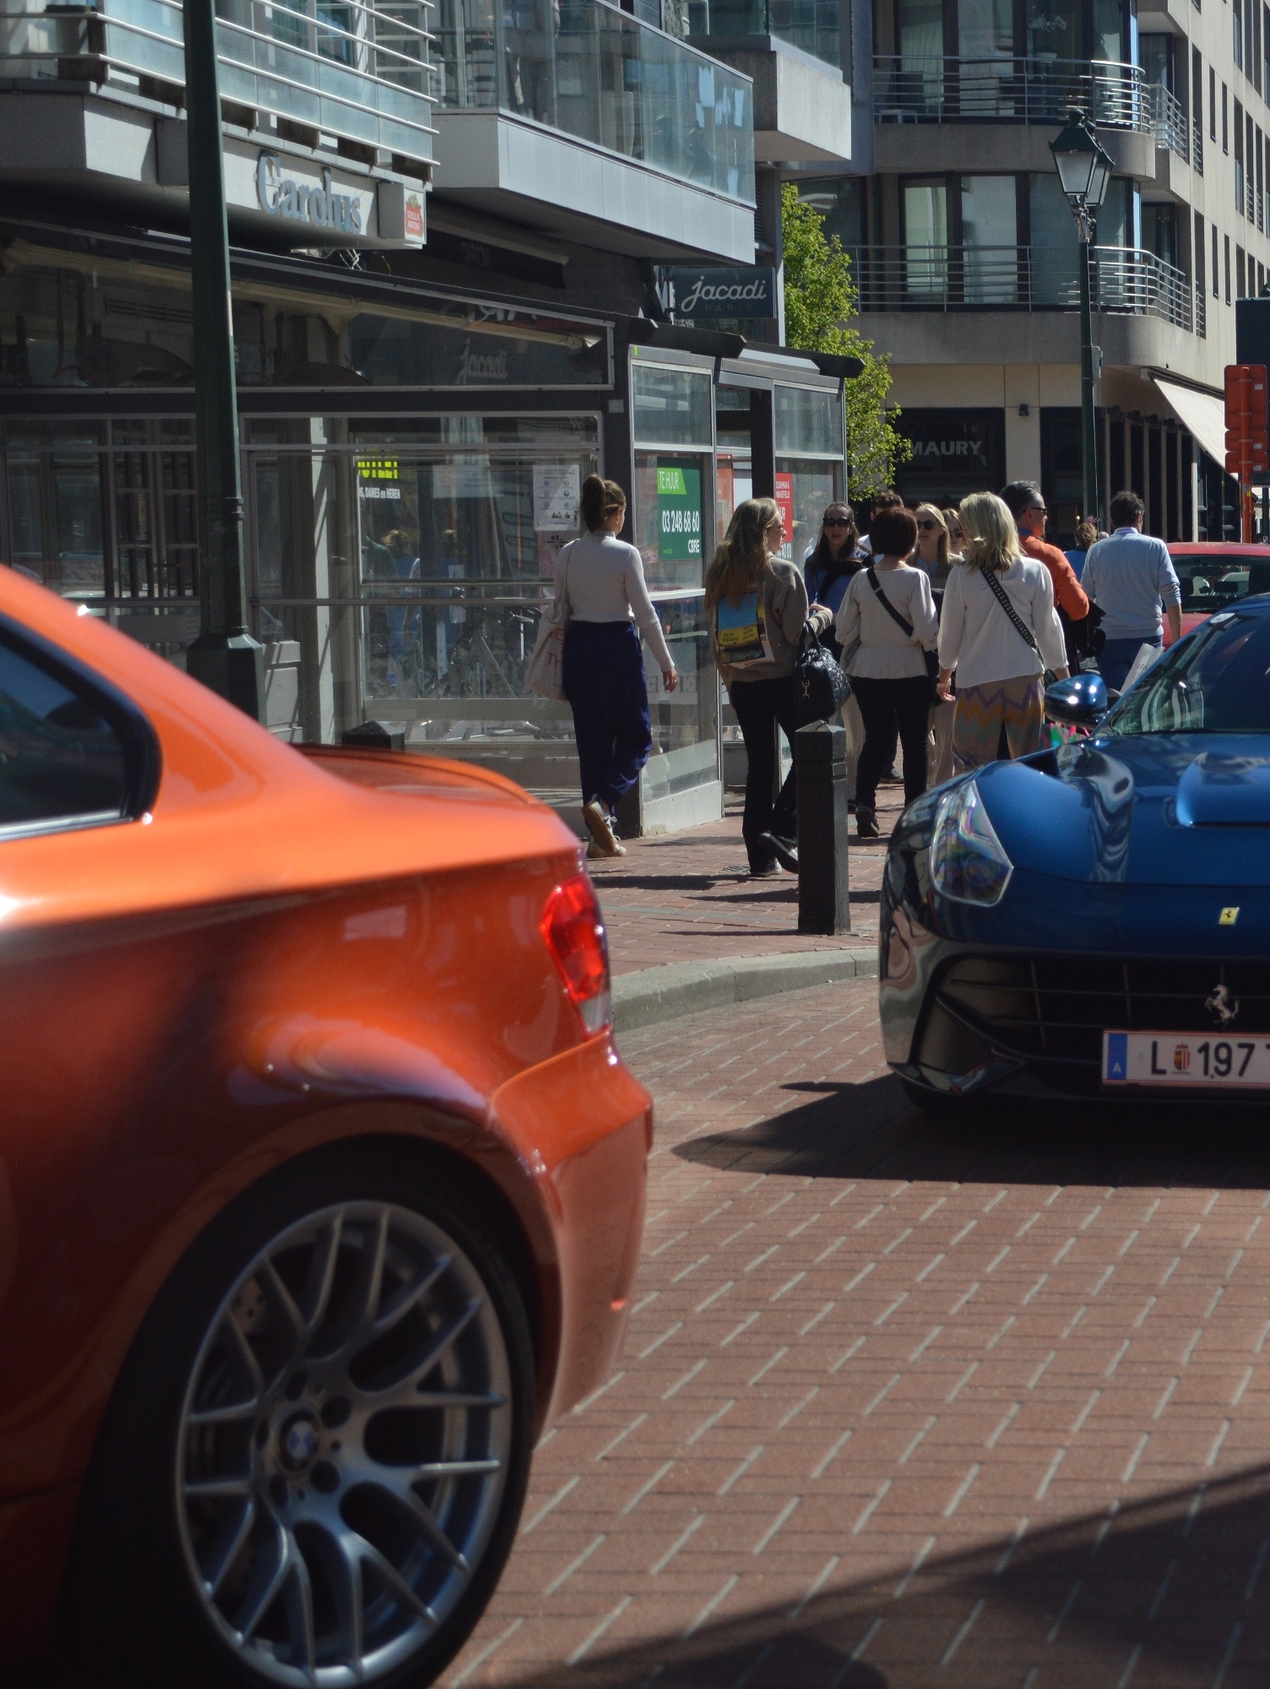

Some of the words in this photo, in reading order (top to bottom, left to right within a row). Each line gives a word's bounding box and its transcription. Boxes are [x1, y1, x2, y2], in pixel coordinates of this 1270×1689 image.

[256, 149, 362, 234] Carolus
[705, 303, 753, 312] PARIS
[659, 471, 665, 489] TE
[666, 471, 679, 490] HUUR
[662, 510, 671, 533] 03
[671, 510, 683, 533] 248
[683, 510, 691, 533] 68
[692, 510, 700, 533] 60
[688, 539, 700, 553] CBRE
[1112, 1062, 1121, 1073] A
[1151, 1041, 1167, 1075] L
[1197, 1041, 1256, 1077] 197
